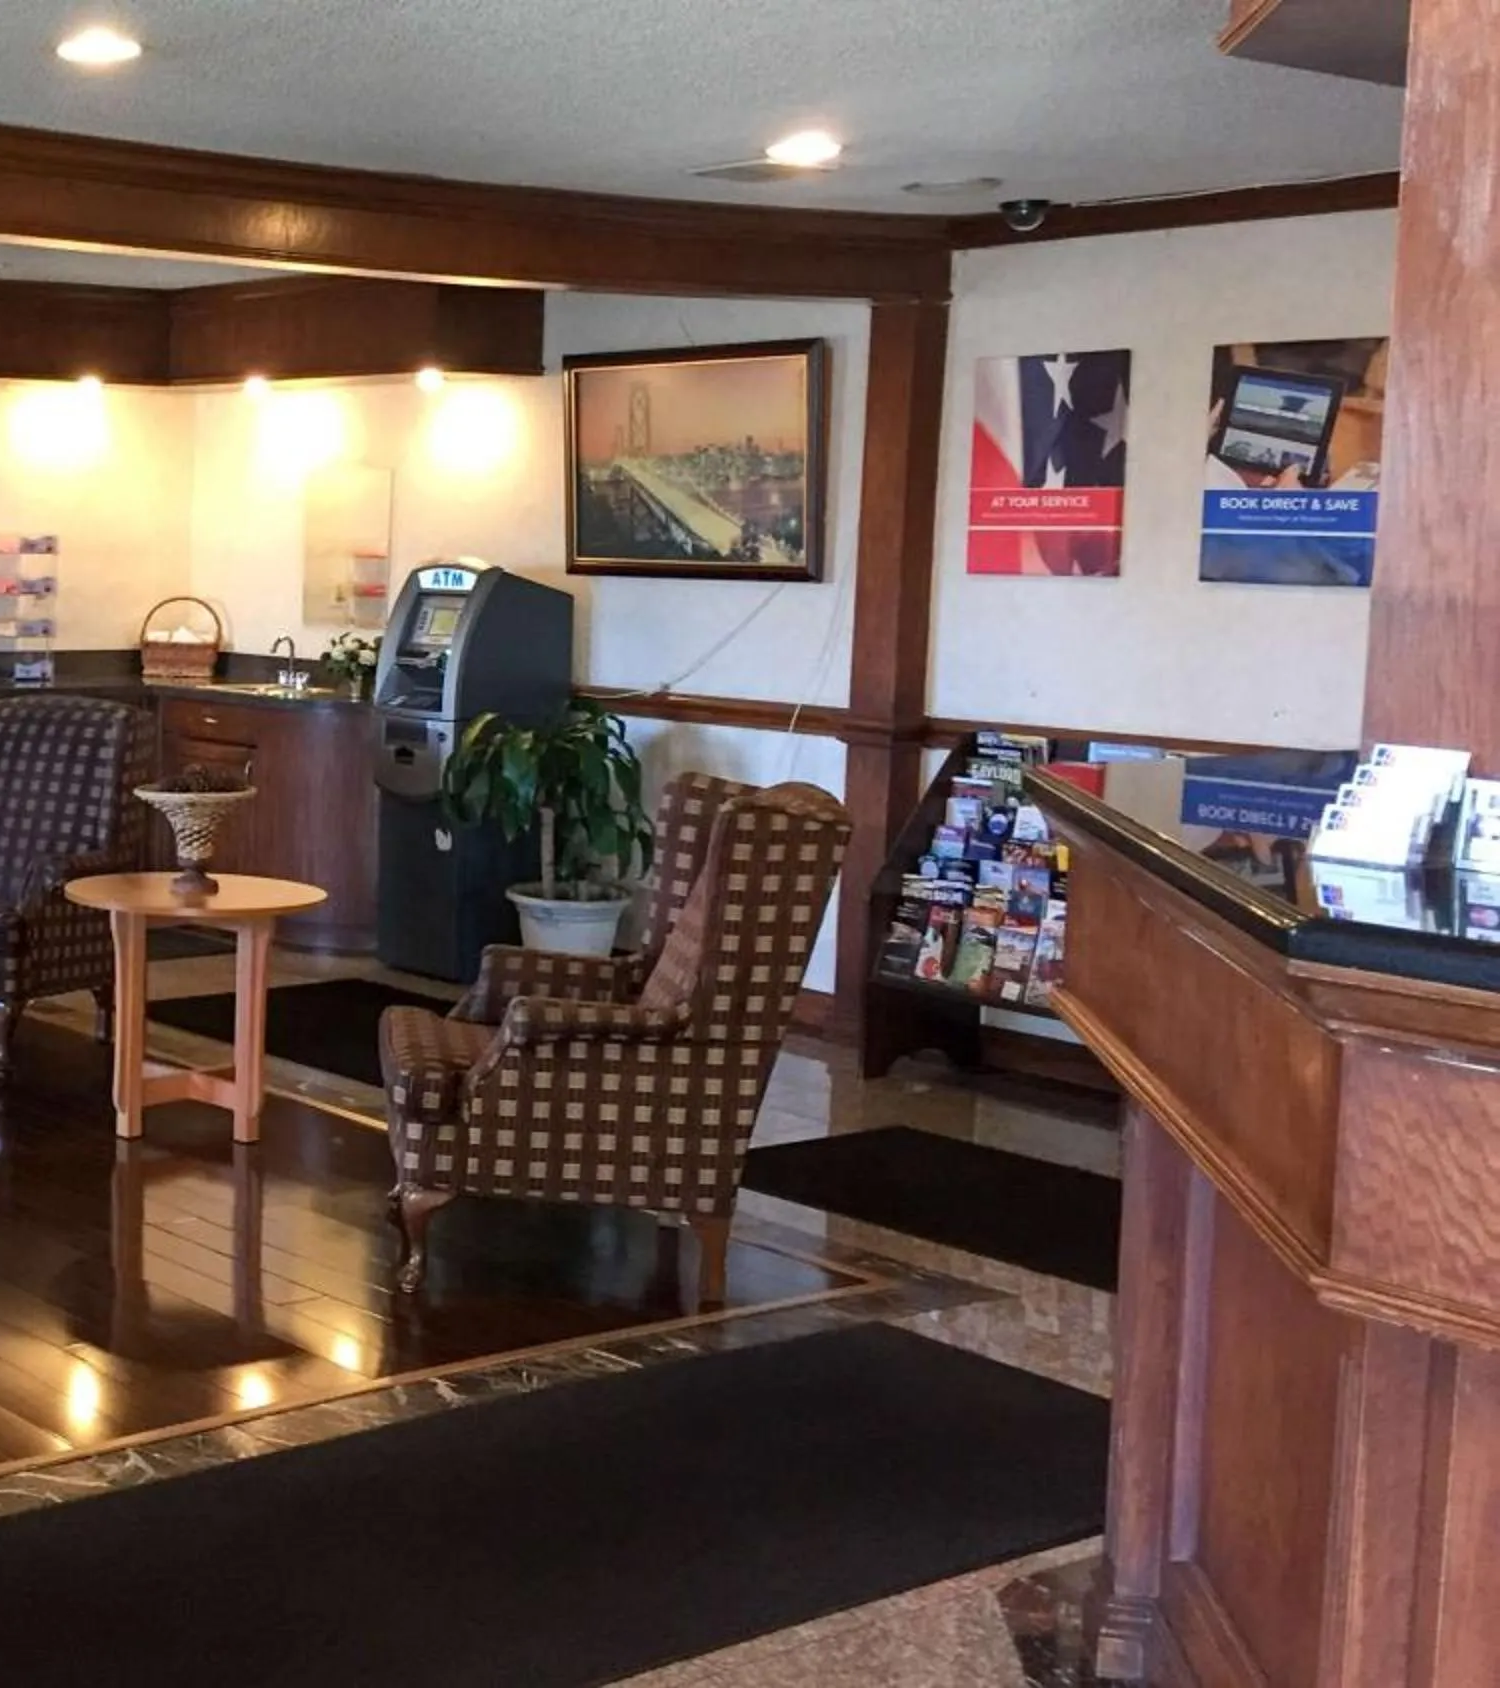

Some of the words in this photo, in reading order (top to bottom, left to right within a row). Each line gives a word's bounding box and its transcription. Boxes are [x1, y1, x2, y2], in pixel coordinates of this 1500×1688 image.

[990, 496, 1005, 509] AT
[1007, 495, 1039, 509] YOUR
[1041, 495, 1089, 509] SERVICE
[1219, 497, 1260, 509] BOOK
[1261, 497, 1308, 511] DIRECT
[1311, 498, 1322, 511] &
[1324, 498, 1360, 511] SAVE
[432, 571, 463, 586] ATM
